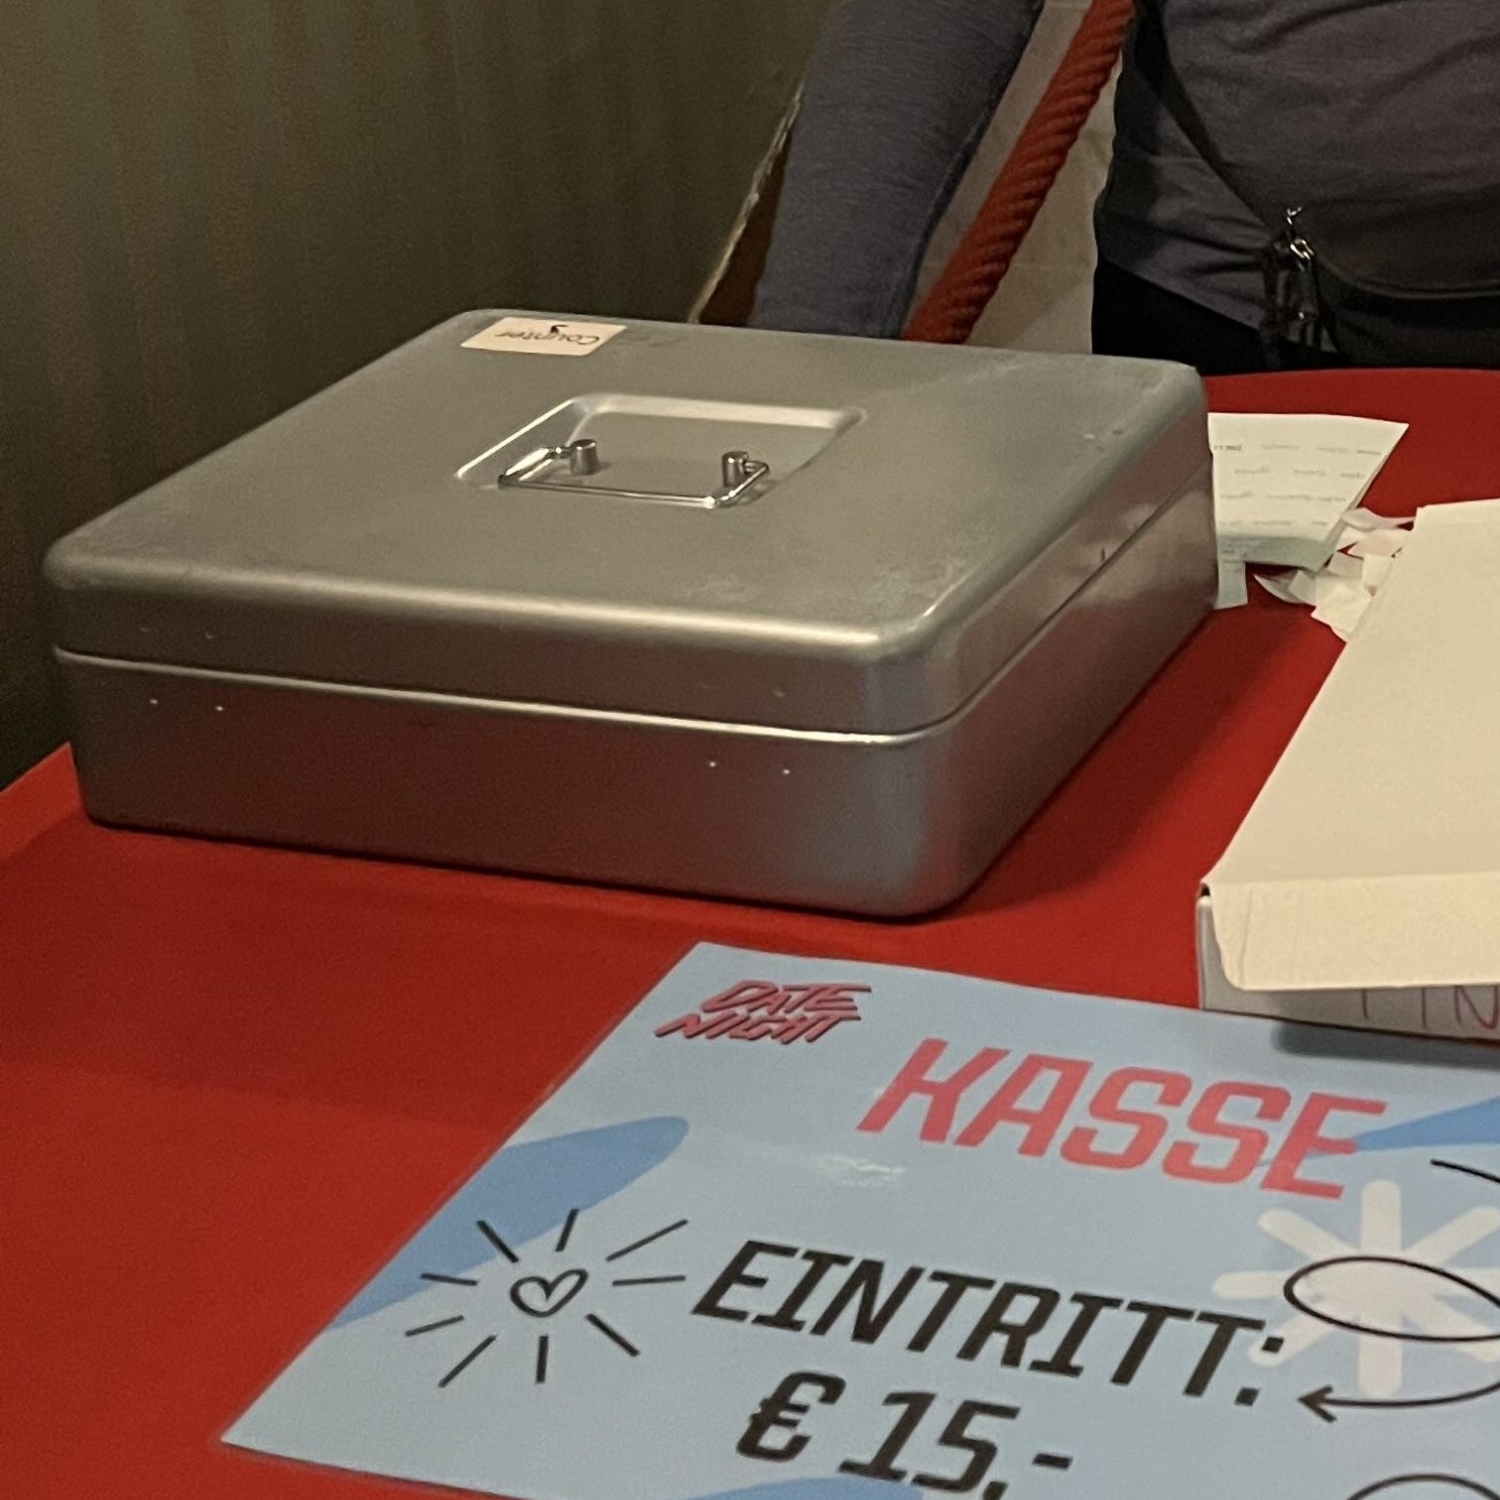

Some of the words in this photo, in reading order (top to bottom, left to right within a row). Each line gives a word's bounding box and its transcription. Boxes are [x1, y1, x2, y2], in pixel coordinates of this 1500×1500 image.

[495, 330, 600, 346] Counter
[653, 1009, 861, 1044] NIGHT
[701, 980, 872, 1015] DATE
[856, 1037, 1387, 1199] KASSE
[691, 1240, 1284, 1406] EINTRITT:
[736, 1371, 846, 1462] €
